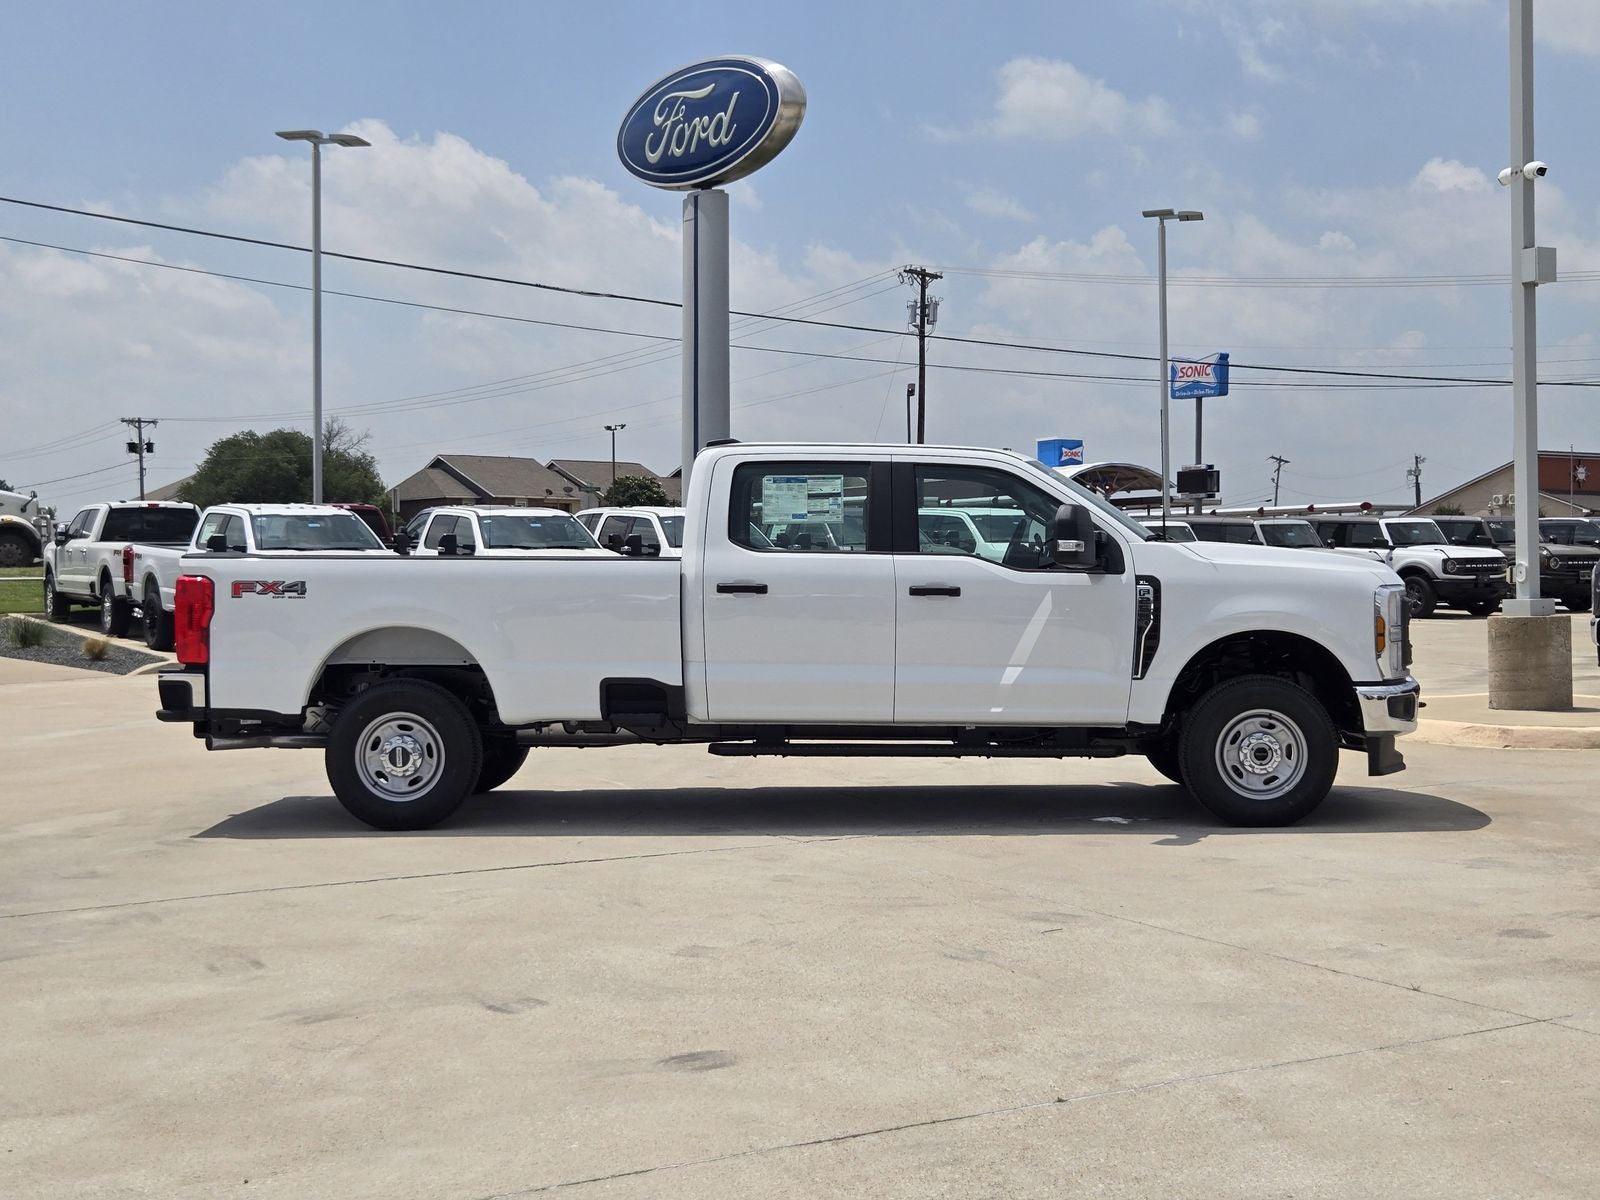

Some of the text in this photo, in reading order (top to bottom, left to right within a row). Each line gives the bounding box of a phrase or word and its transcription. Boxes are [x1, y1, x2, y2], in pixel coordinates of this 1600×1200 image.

[645, 83, 740, 164] Ford
[1179, 364, 1211, 378] SONIC
[231, 580, 307, 598] FX4
